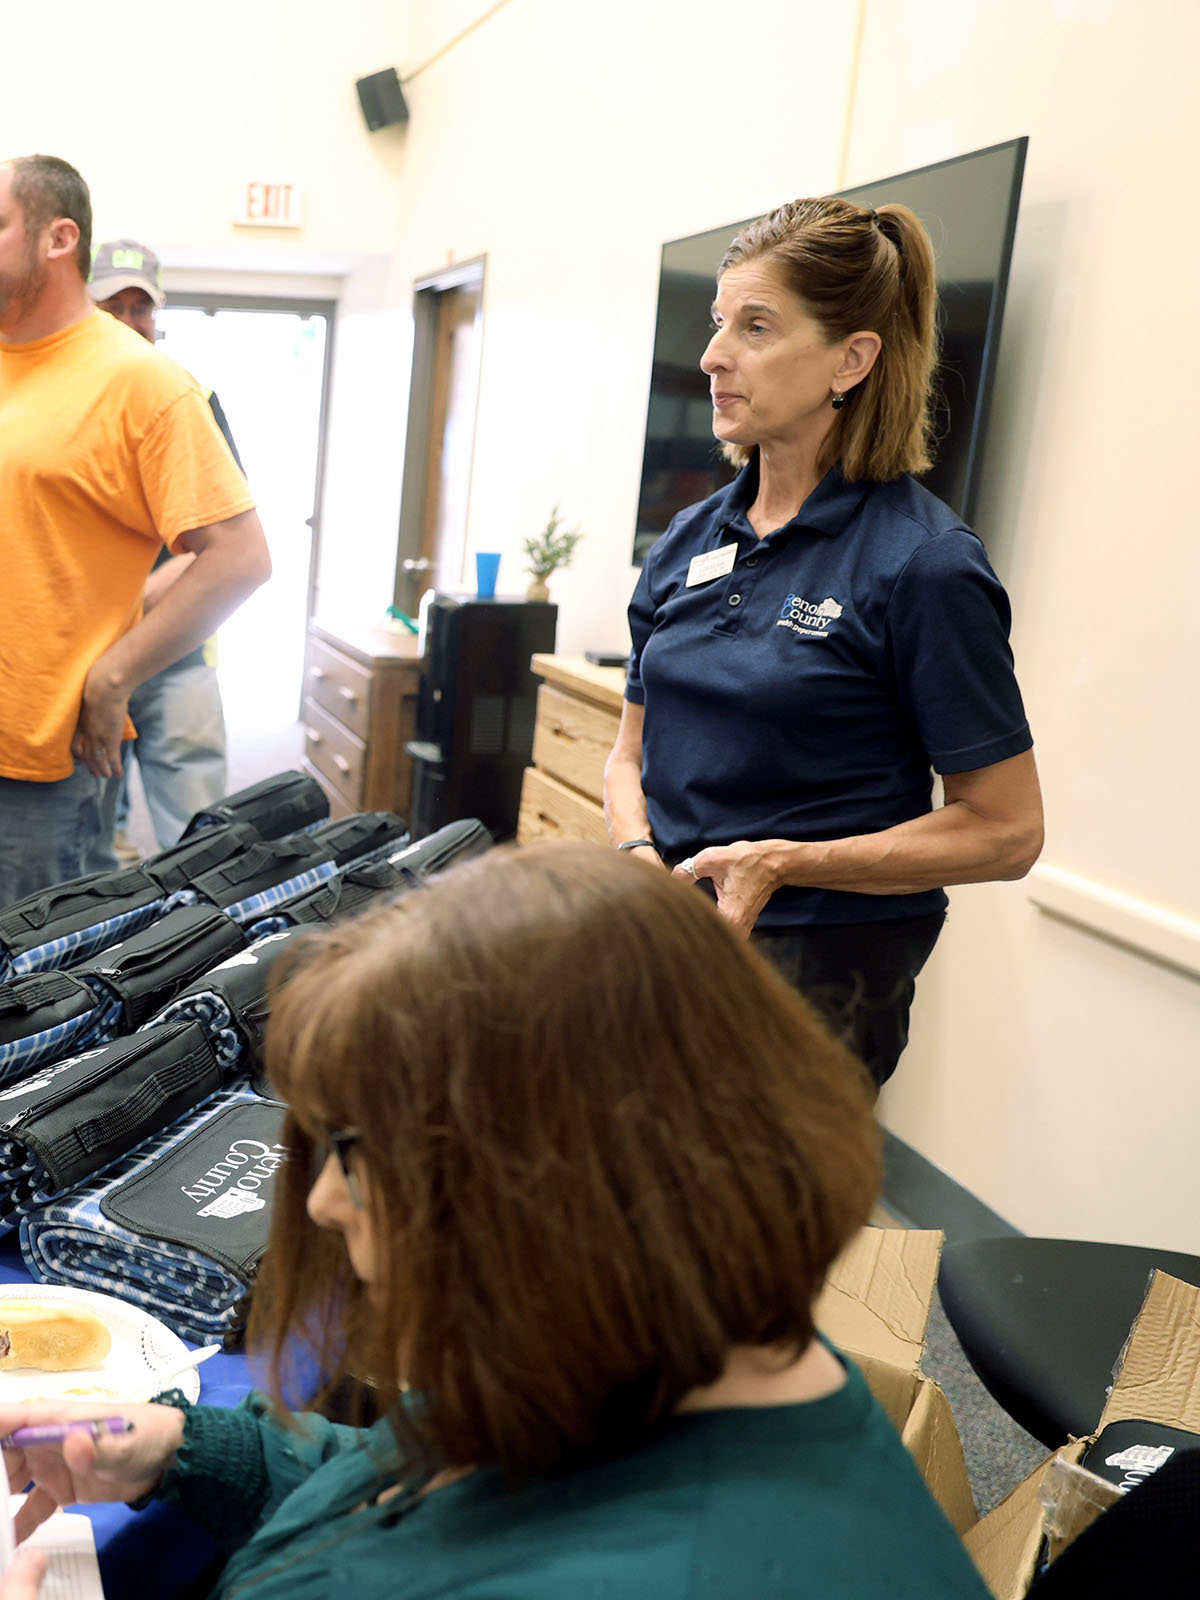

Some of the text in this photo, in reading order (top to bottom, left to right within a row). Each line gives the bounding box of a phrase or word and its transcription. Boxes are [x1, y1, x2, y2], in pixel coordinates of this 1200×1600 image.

[246, 183, 293, 219] EXIT
[780, 605, 832, 630] County
[784, 593, 818, 615] Reno
[180, 1139, 271, 1204] County
